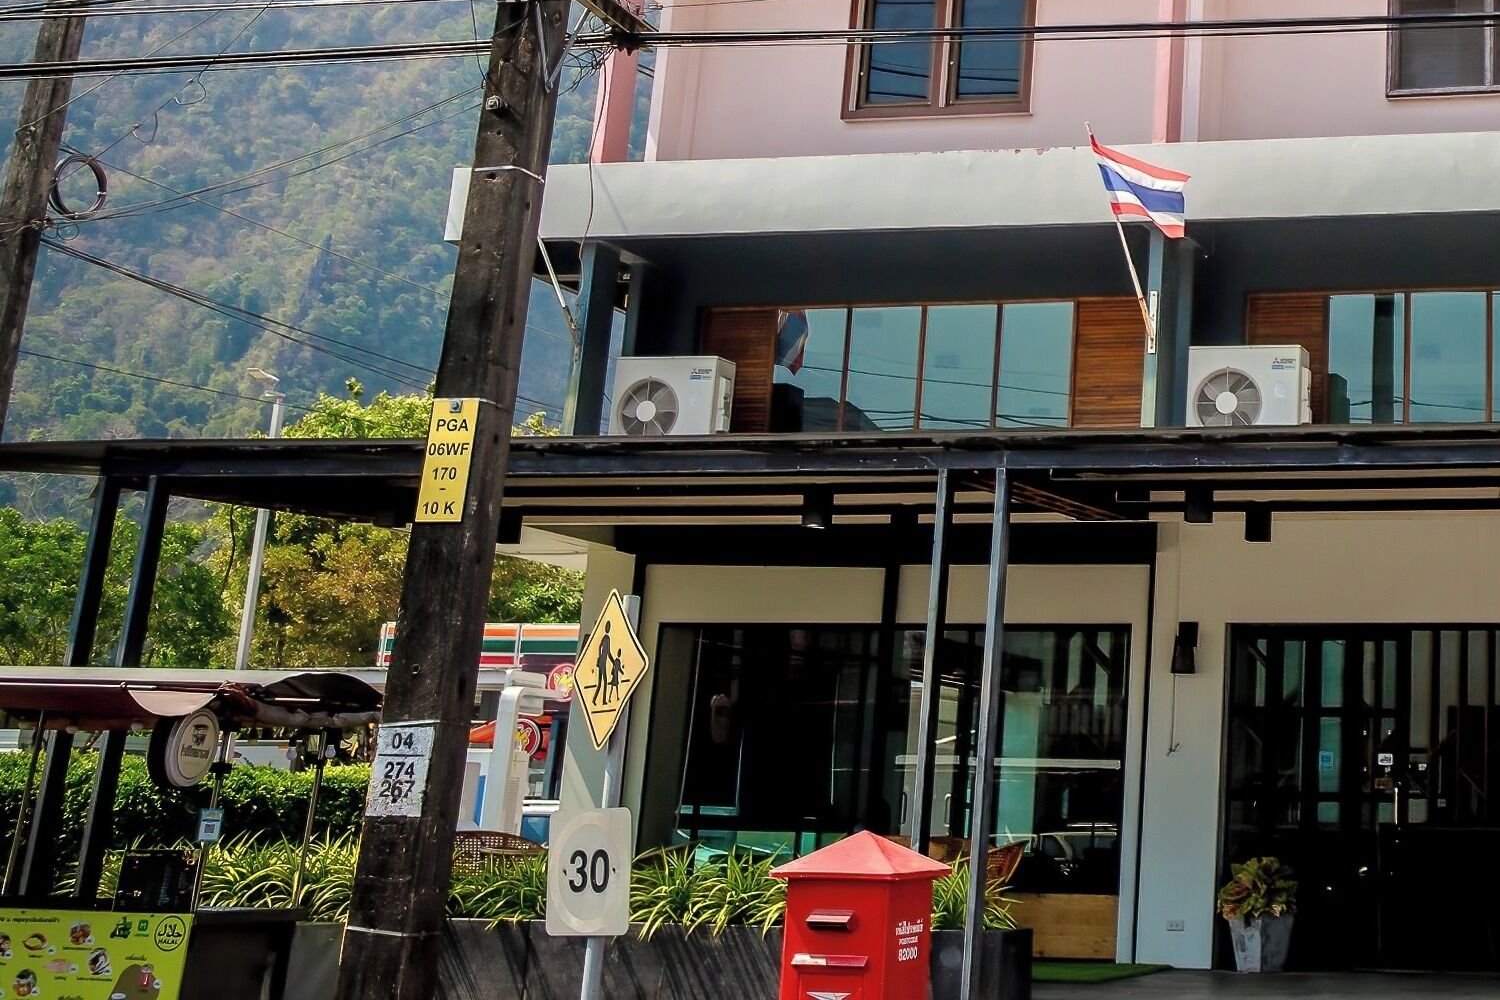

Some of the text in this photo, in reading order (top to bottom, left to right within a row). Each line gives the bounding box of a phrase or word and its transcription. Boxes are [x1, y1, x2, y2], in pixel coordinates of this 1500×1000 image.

[436, 419, 469, 432] PGA
[428, 442, 470, 456] 06WF
[432, 467, 457, 480] 170
[422, 501, 455, 515] 10 K
[391, 732, 414, 750] 04
[383, 761, 416, 780] 274
[568, 848, 610, 893] 30
